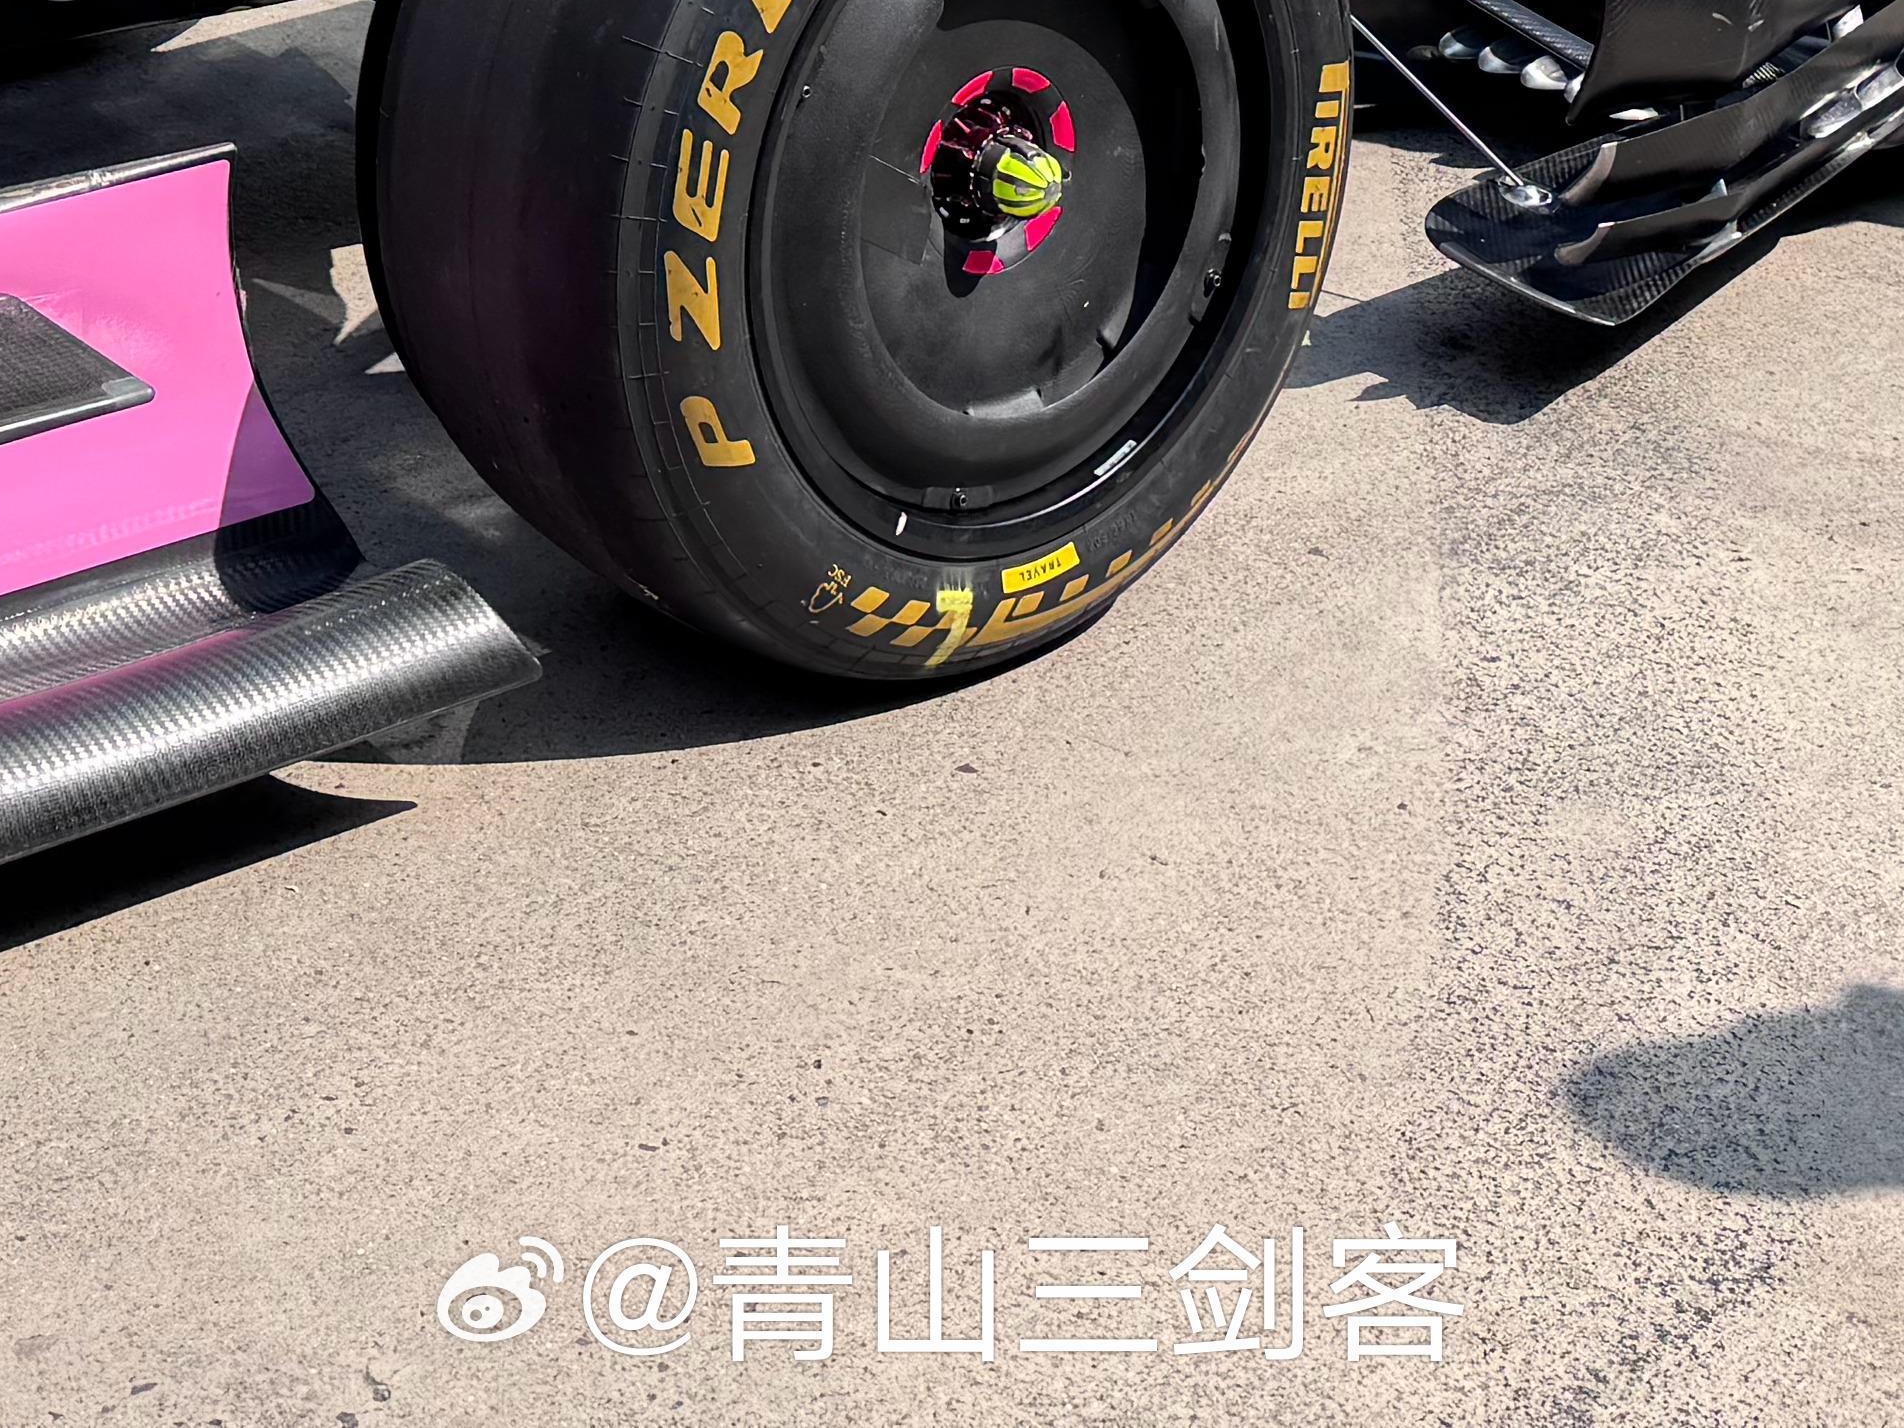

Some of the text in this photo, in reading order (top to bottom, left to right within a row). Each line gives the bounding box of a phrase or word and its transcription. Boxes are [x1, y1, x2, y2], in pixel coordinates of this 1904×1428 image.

[1288, 61, 1353, 310] PIRELLI
[680, 395, 757, 469] P
[1018, 557, 1063, 582] TRAVEL
